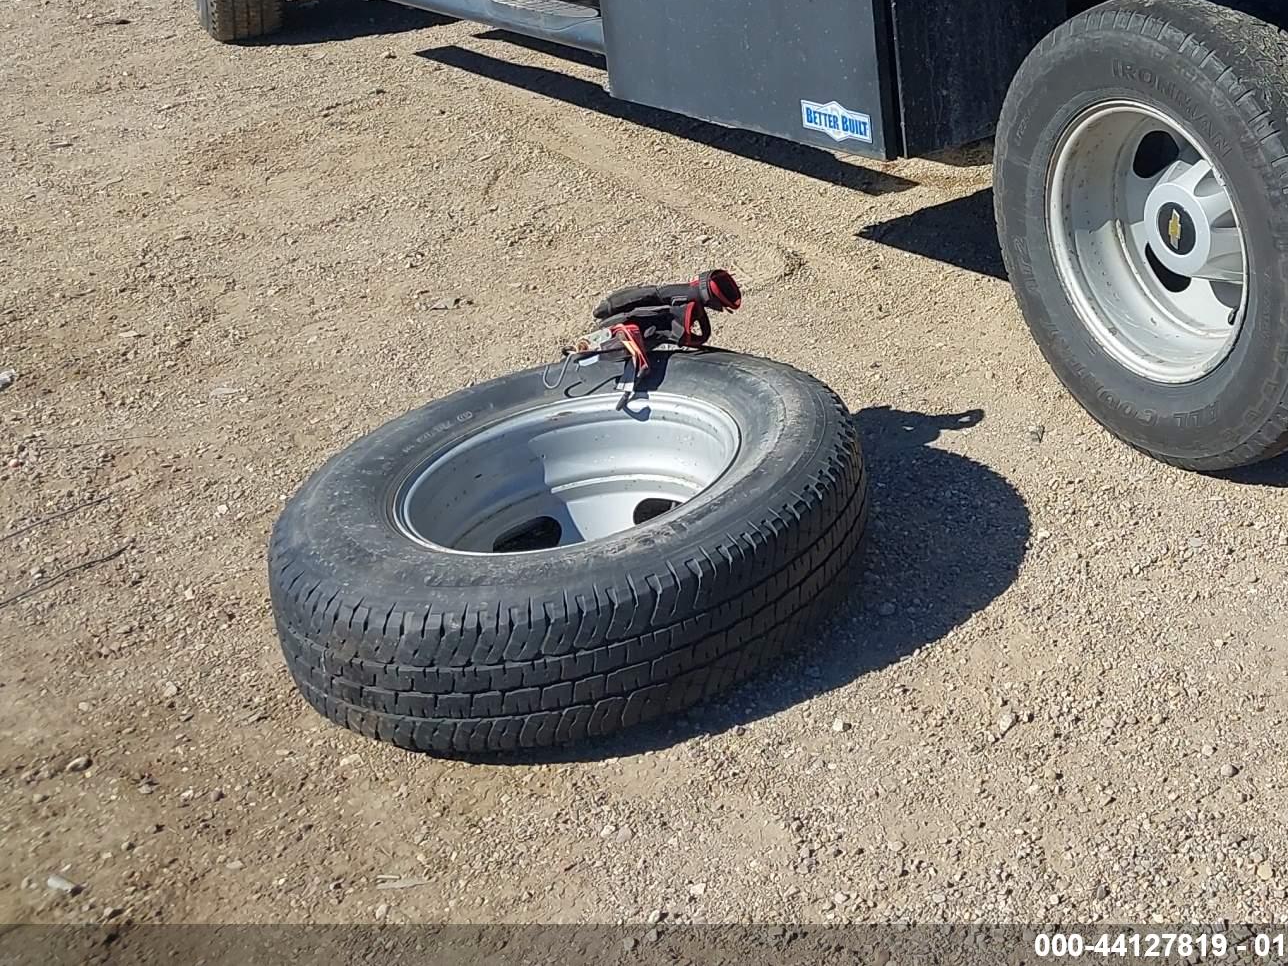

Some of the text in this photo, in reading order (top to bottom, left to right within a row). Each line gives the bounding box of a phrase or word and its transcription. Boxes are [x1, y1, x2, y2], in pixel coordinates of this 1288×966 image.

[805, 106, 868, 137] BETTER BUILT
[1110, 57, 1232, 158] IRONMAN
[1172, 399, 1224, 428] ALL
